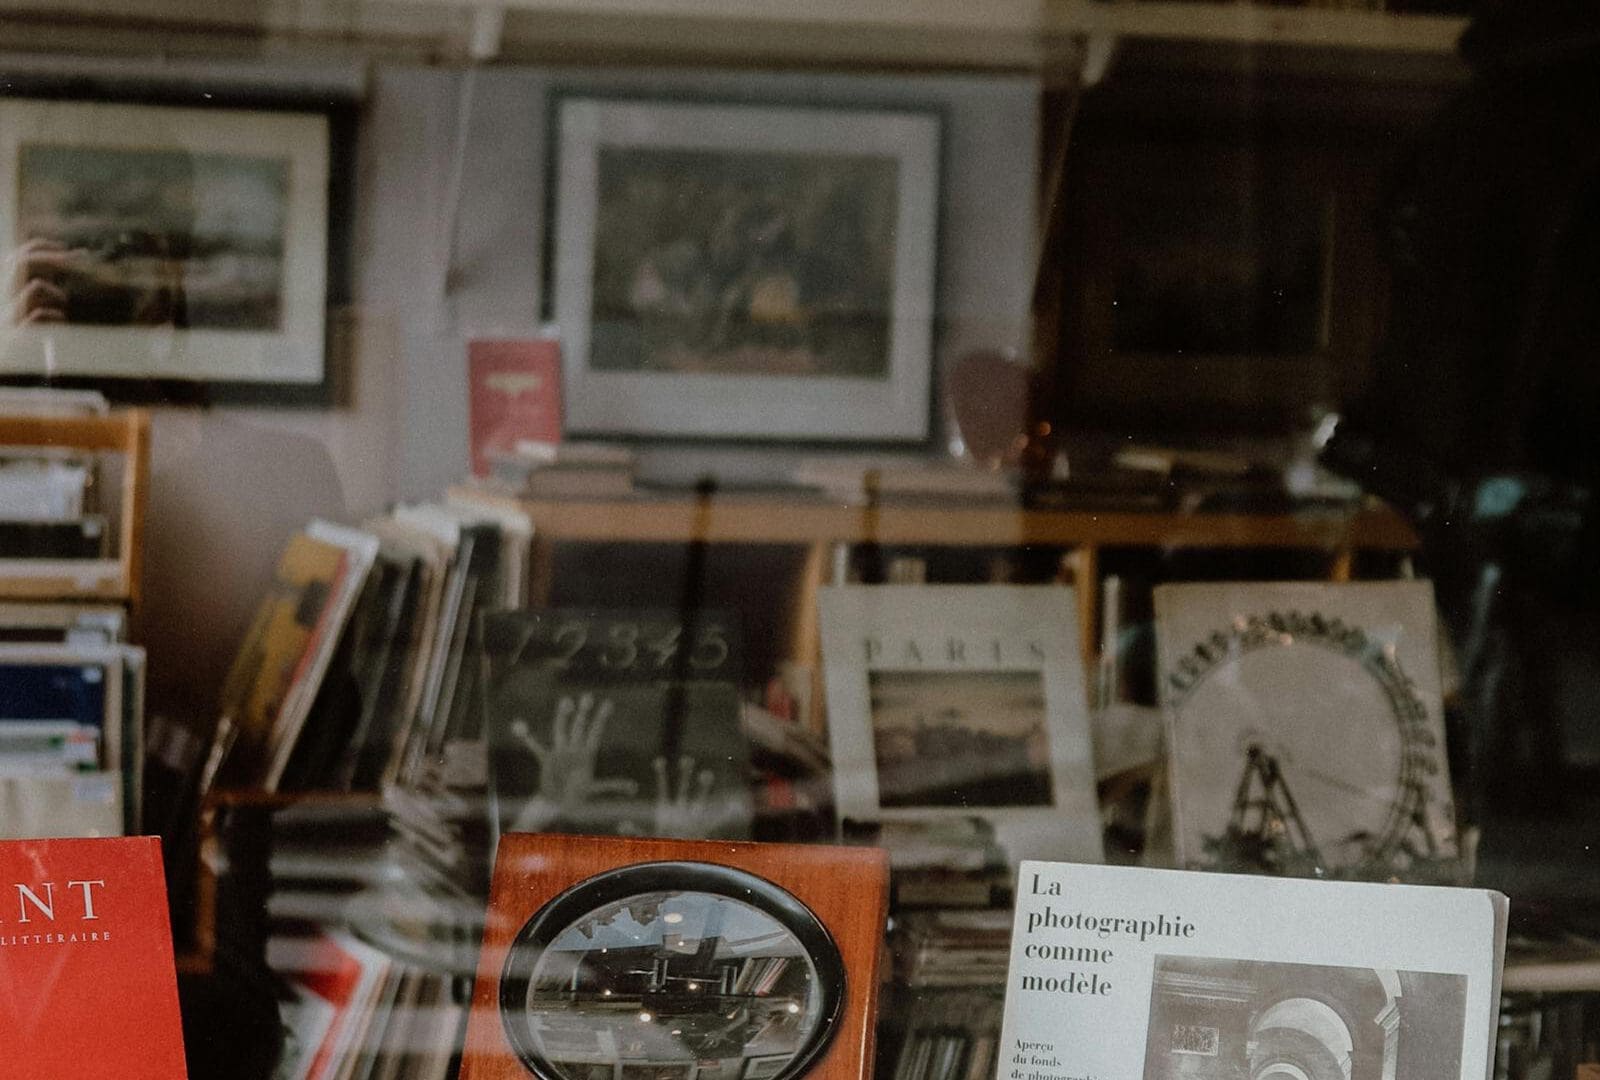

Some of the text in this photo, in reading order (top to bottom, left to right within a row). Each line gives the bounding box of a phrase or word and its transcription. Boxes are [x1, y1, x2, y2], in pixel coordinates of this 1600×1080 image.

[1031, 873, 1062, 896] La
[0, 880, 105, 923] NT
[1027, 906, 1197, 941] photographie
[1025, 943, 1114, 964] comme
[1022, 972, 1112, 996] modèle
[1014, 1038, 1054, 1054] Aperçu
[1012, 1053, 1062, 1067] du fonds
[1010, 1069, 1025, 1080] de
